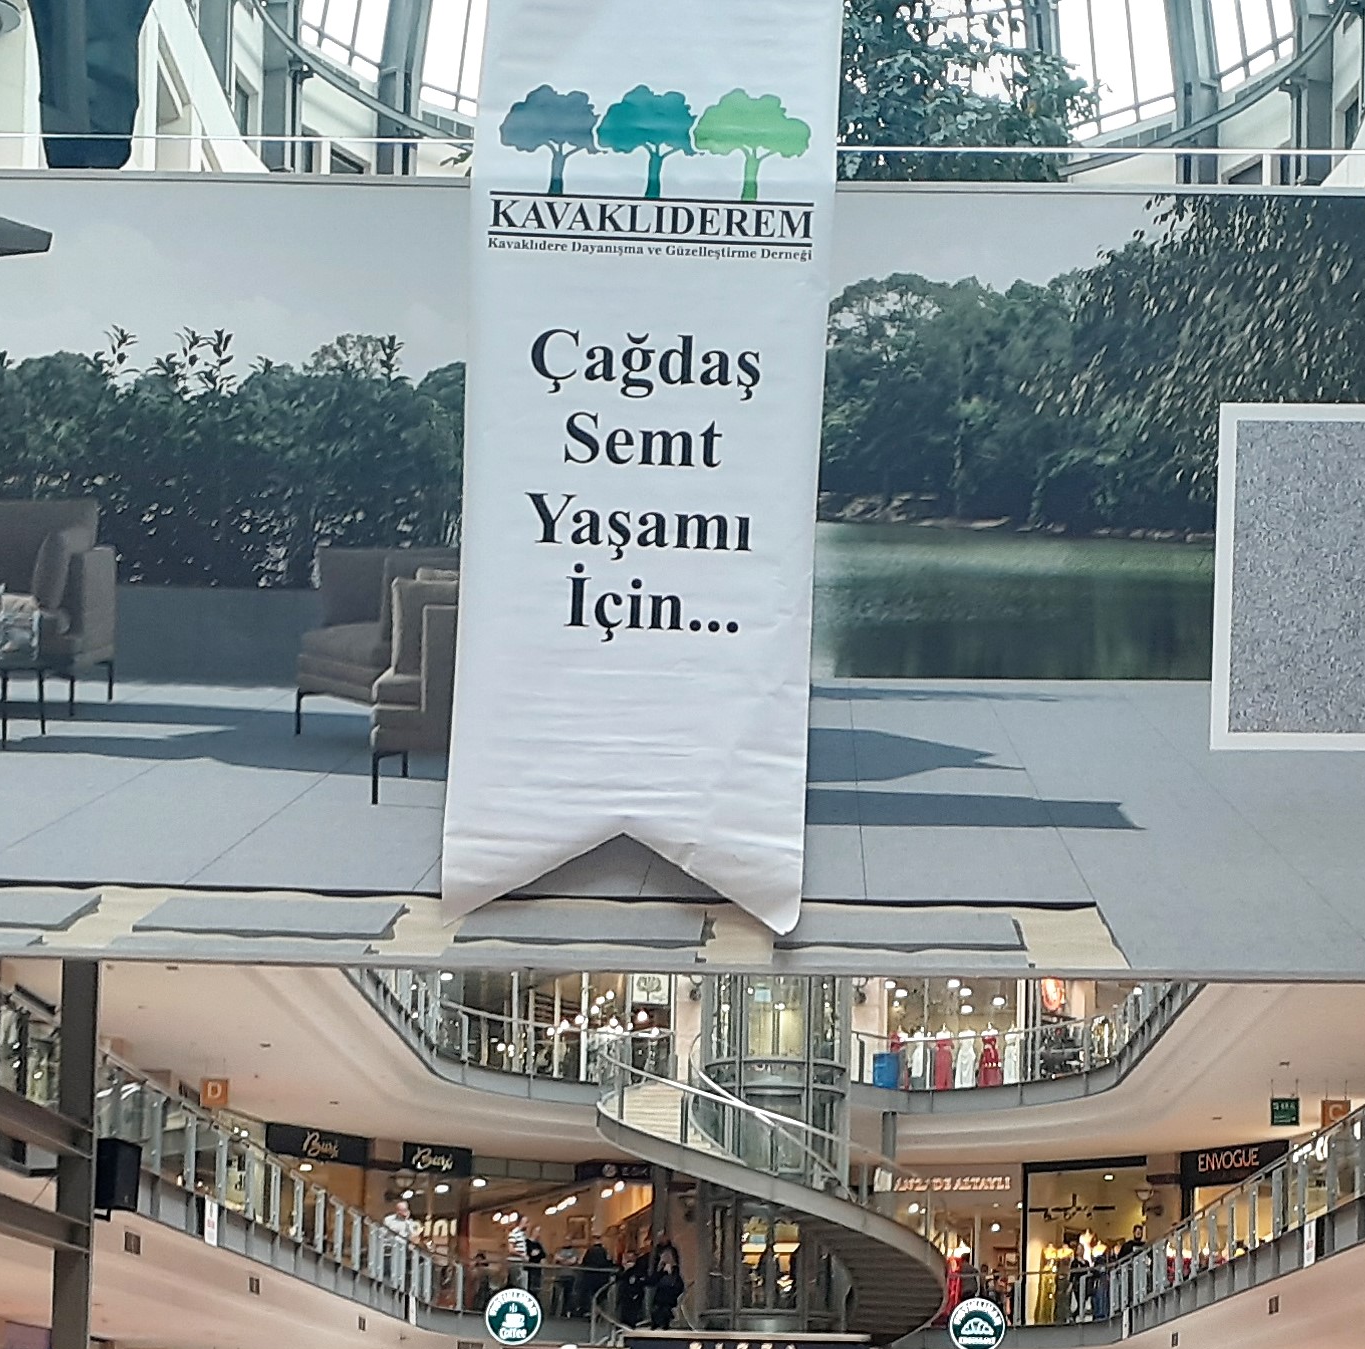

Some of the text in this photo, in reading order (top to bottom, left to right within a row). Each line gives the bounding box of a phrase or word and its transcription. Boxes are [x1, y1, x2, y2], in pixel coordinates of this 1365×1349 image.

[489, 199, 813, 239] KAVAKLIDEREM
[572, 242, 644, 257] Dayanışma
[647, 246, 662, 256] ve
[666, 245, 757, 260] Güzelleştirme
[761, 248, 812, 263] Derneği
[531, 329, 762, 402] Çağdaş
[564, 412, 723, 469] Semt
[525, 492, 752, 562] Yaşamı
[564, 563, 741, 644] İçin...
[207, 1077, 222, 1099] D
[1198, 1148, 1260, 1173] ENVOGUE
